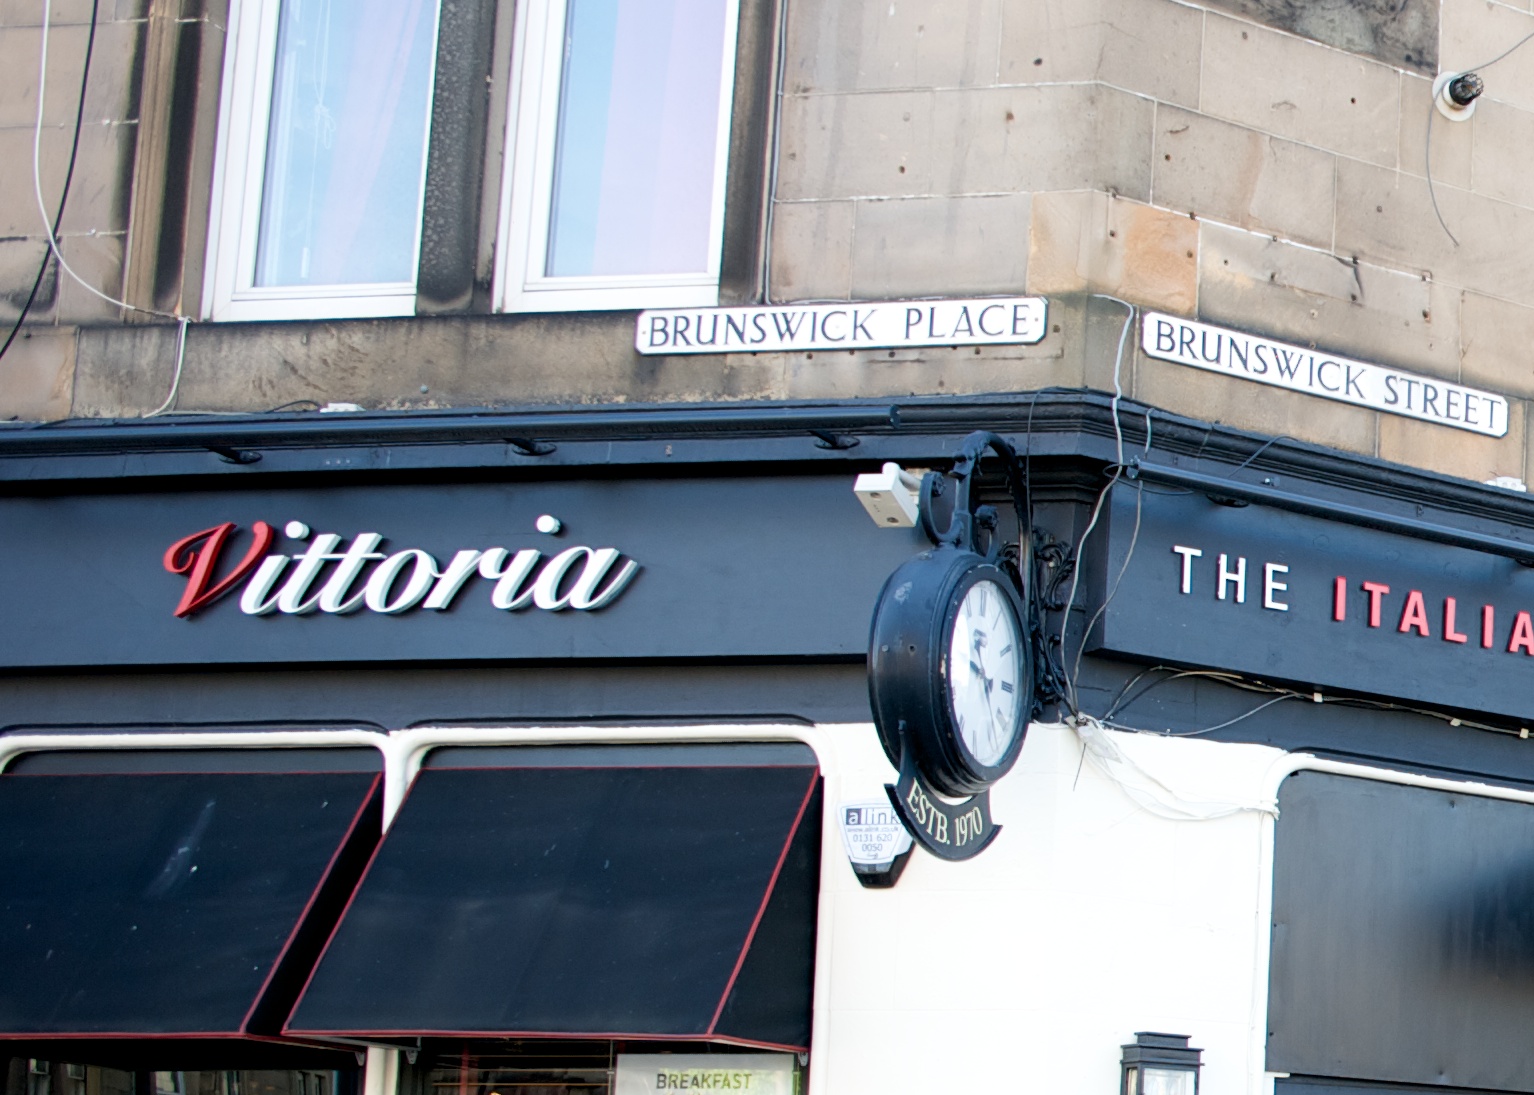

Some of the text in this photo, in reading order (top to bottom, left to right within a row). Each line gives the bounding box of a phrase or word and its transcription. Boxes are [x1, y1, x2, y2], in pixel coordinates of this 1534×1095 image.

[648, 304, 1032, 346] BRUNSWICK PLACE
[1155, 320, 1502, 430] BRUNSWICK STREET
[163, 514, 640, 618] Vittoria
[1173, 545, 1290, 612] THE
[853, 834, 872, 842] 0131
[907, 777, 983, 847] ESTB. 1970
[656, 1073, 752, 1089] BREAKFAST
